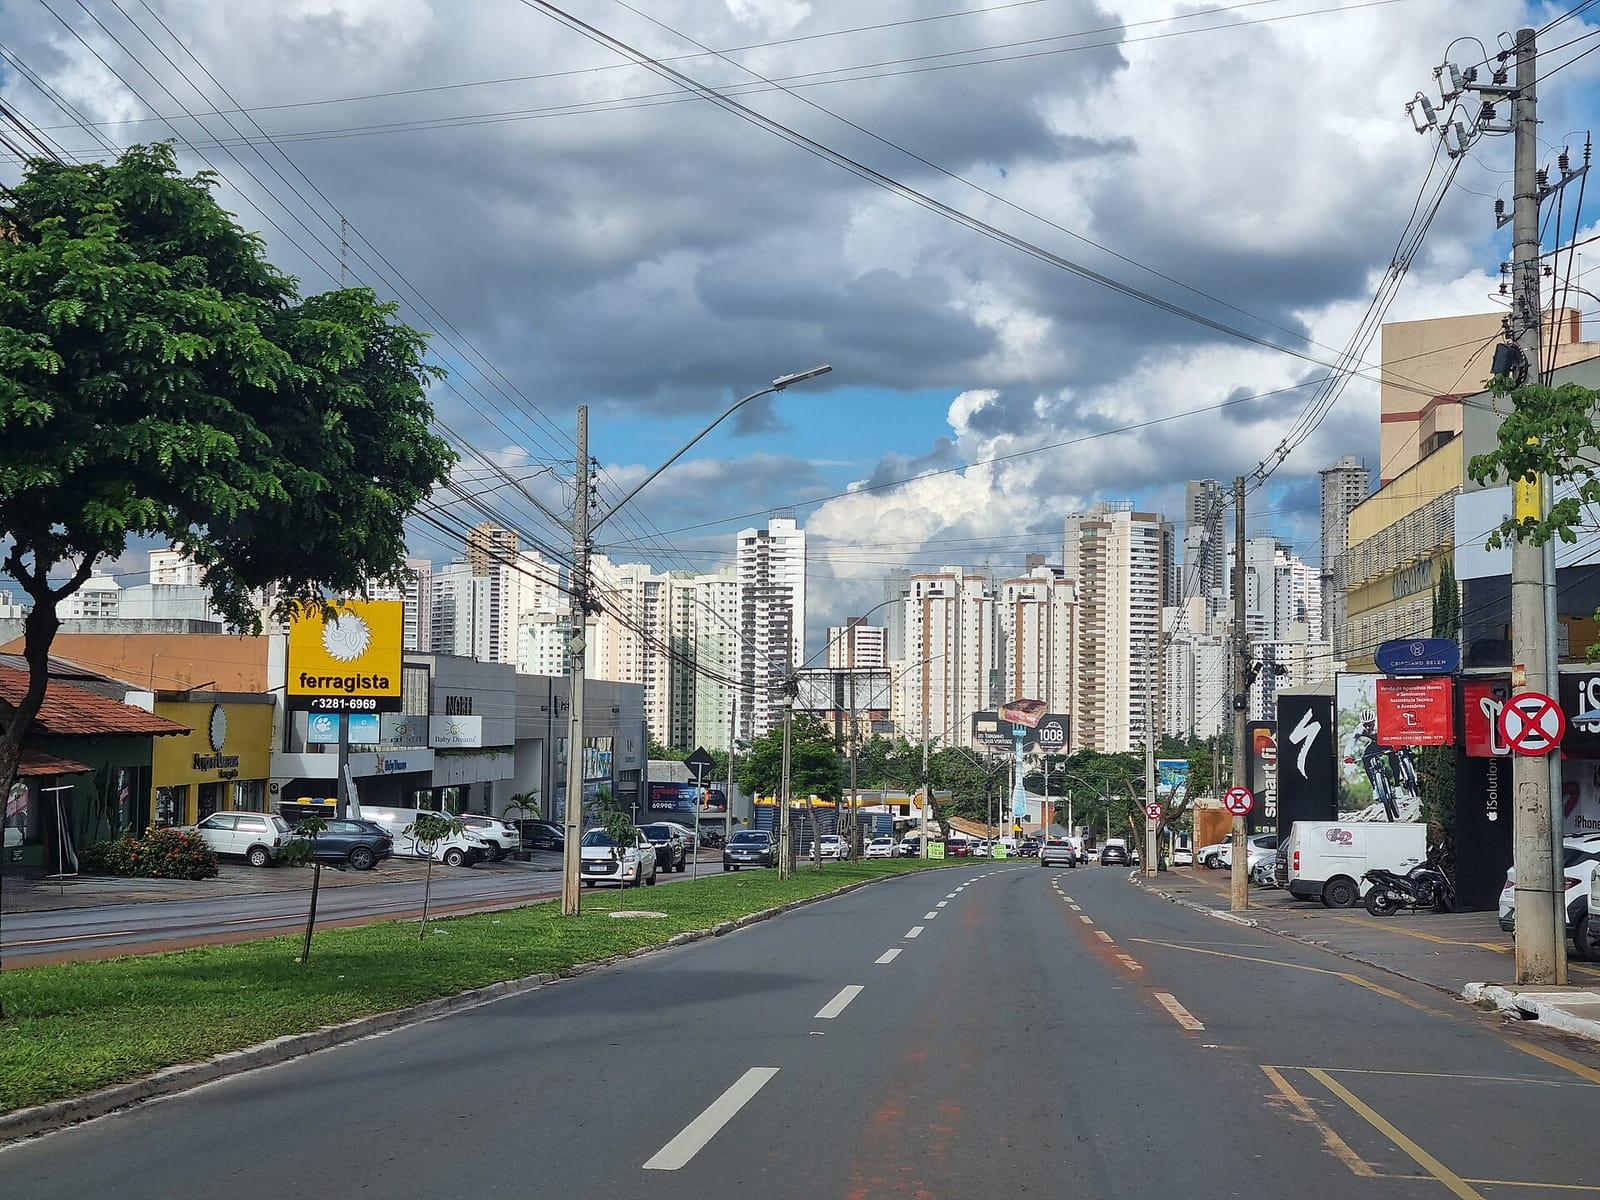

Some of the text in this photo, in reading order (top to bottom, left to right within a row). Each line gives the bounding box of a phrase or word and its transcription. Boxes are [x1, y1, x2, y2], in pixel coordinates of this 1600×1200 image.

[299, 672, 390, 693] ferragista
[319, 698, 377, 709] 3281-6969
[434, 735, 450, 744] Baby
[1039, 729, 1063, 741] 1008
[1262, 763, 1277, 818] smart
[1486, 758, 1498, 810] iSolution
